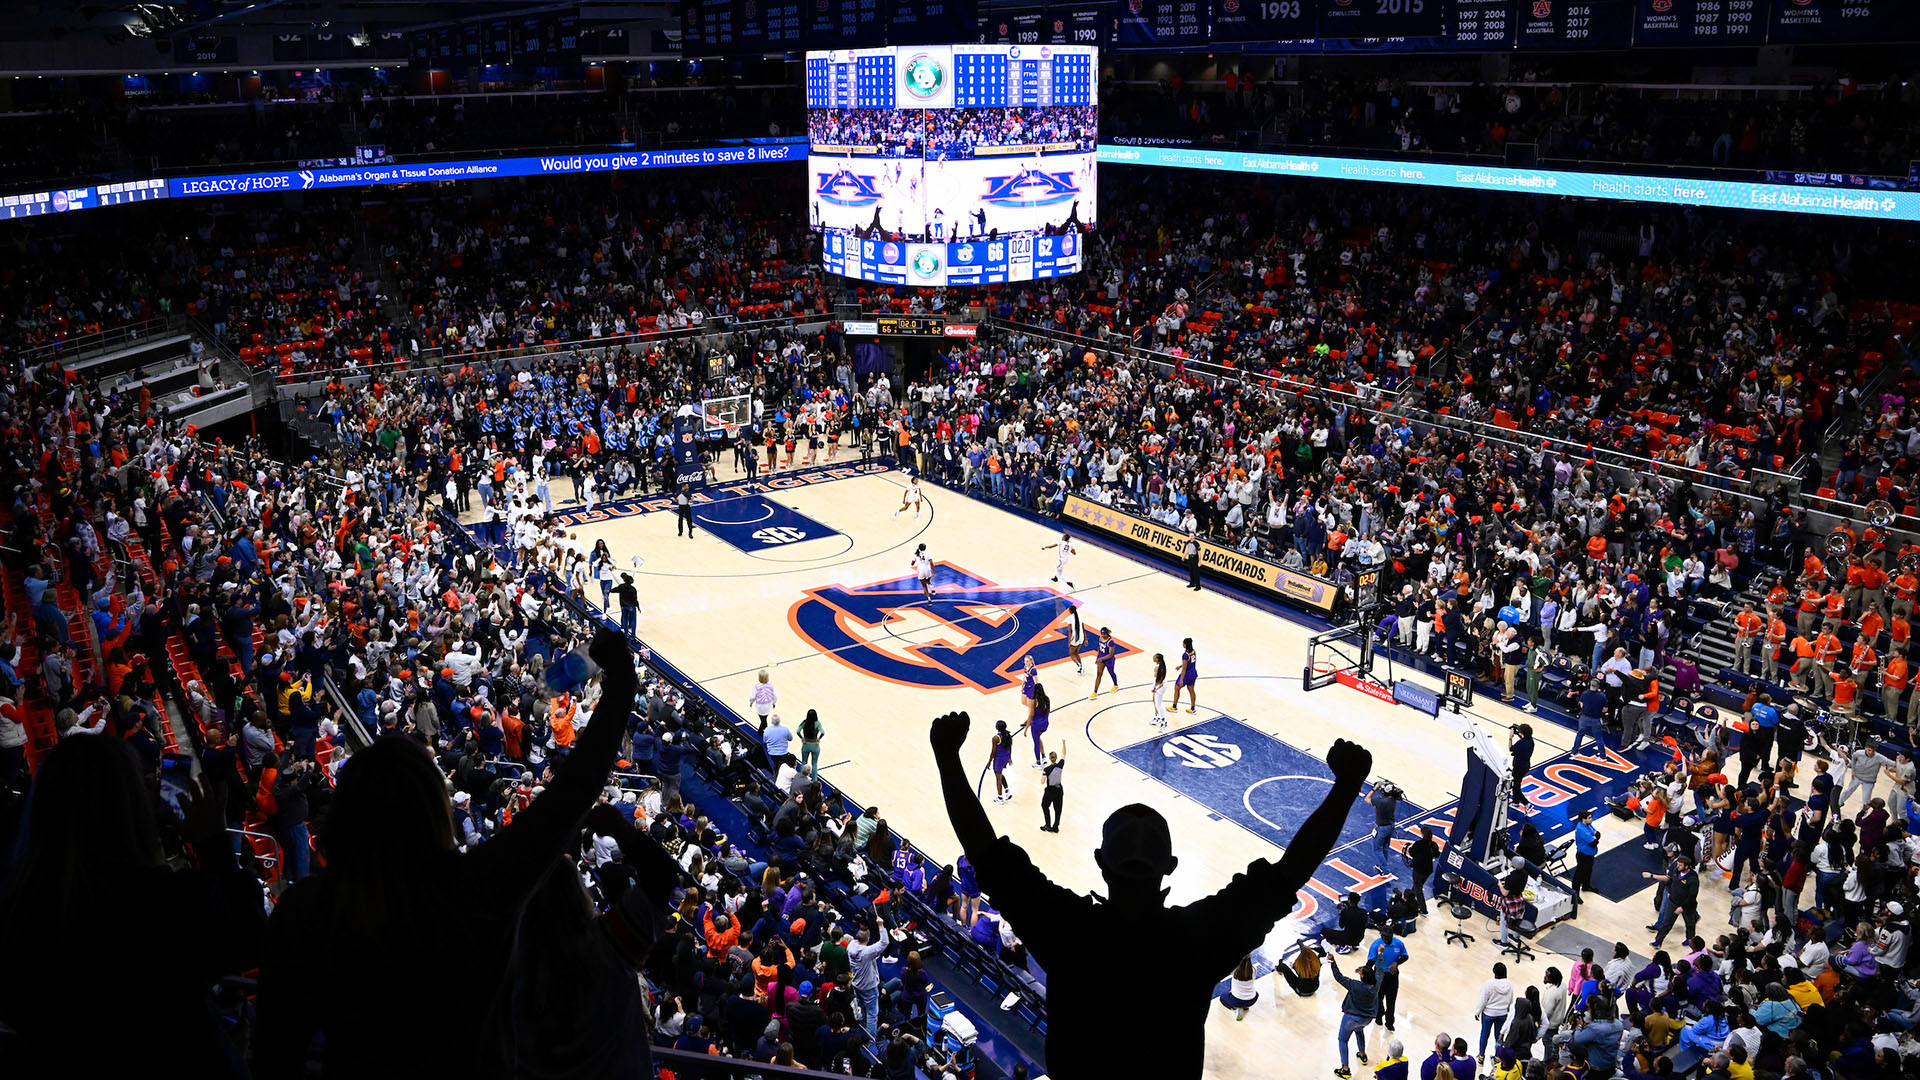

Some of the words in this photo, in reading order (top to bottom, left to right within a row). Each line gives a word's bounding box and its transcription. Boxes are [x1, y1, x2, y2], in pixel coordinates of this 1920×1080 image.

[1157, 5, 1172, 14] 1991
[1179, 3, 1196, 13] 2015
[1260, 2, 1301, 20] 1993
[1375, 0, 1424, 15] 2015
[1567, 7, 1590, 16] 2016
[1696, 2, 1720, 11] 1986
[1728, 0, 1752, 10] 1989
[1328, 9, 1361, 17] GYMNASTICS
[1458, 10, 1478, 20] 1997
[1483, 9, 1506, 19] 2004
[1695, 13, 1719, 23] 1987
[1727, 12, 1752, 22] 1990
[1783, 9, 1819, 17] WOMEN'S
[1840, 7, 1870, 18] 1996
[1157, 16, 1173, 25] 1993
[1179, 14, 1197, 24] 2016
[1458, 21, 1477, 30] 1999
[1483, 20, 1505, 30] 2008
[1566, 18, 1589, 27] 2017
[1643, 21, 1679, 29] BASKETBALL
[1780, 16, 1822, 25] BASKETBALL
[1073, 29, 1097, 41] 1990
[1156, 27, 1175, 36] 2003
[1179, 26, 1198, 35] 2022
[1565, 29, 1588, 39] 2019
[1693, 25, 1718, 35] 1988
[1725, 24, 1749, 34] 1991
[1017, 31, 1039, 43] 1989
[1456, 32, 1477, 41] 2000
[1482, 31, 1505, 41] 2009
[540, 156, 582, 171] Would
[584, 159, 609, 172] you
[611, 156, 638, 170] give
[641, 153, 649, 166] 2
[652, 152, 700, 165] minutes
[702, 152, 715, 162] to
[717, 151, 745, 162] save
[747, 148, 756, 160] 8
[758, 146, 789, 159] lives?
[1159, 151, 1181, 163] Health
[1182, 154, 1202, 164] starts
[1204, 156, 1224, 166] here.
[318, 171, 362, 183] Alabama's
[364, 170, 390, 182] Organ
[392, 170, 399, 178] &
[400, 168, 427, 178] Tissue
[428, 166, 465, 176] Donation
[466, 164, 497, 174] Alliance
[1340, 163, 1369, 176] Health
[1370, 166, 1396, 177] starts
[1399, 167, 1426, 179] here.
[182, 179, 238, 194] LEGACY
[238, 177, 250, 192] of
[252, 176, 290, 190] HOPE
[1592, 181, 1631, 194] Health
[1633, 183, 1668, 197] starts
[1673, 186, 1708, 200] here.
[832, 236, 841, 254] 66
[864, 241, 875, 260] 62
[1011, 239, 1031, 254] 02.0
[1038, 238, 1053, 257] 62
[988, 242, 1004, 261] 66
[882, 325, 892, 334] 66
[900, 320, 917, 328] 02.0
[931, 326, 942, 335] 62
[718, 463, 889, 497] TIGERS
[752, 526, 807, 544] SEC
[1130, 522, 1151, 541] FOR
[1150, 529, 1190, 554] FIVE-ST
[1202, 548, 1268, 583] BACKYARDS.
[1287, 579, 1312, 592] YellaWood
[1403, 690, 1434, 707] RENASANT
[1162, 734, 1242, 769] SEC
[896, 857, 907, 869] 13
